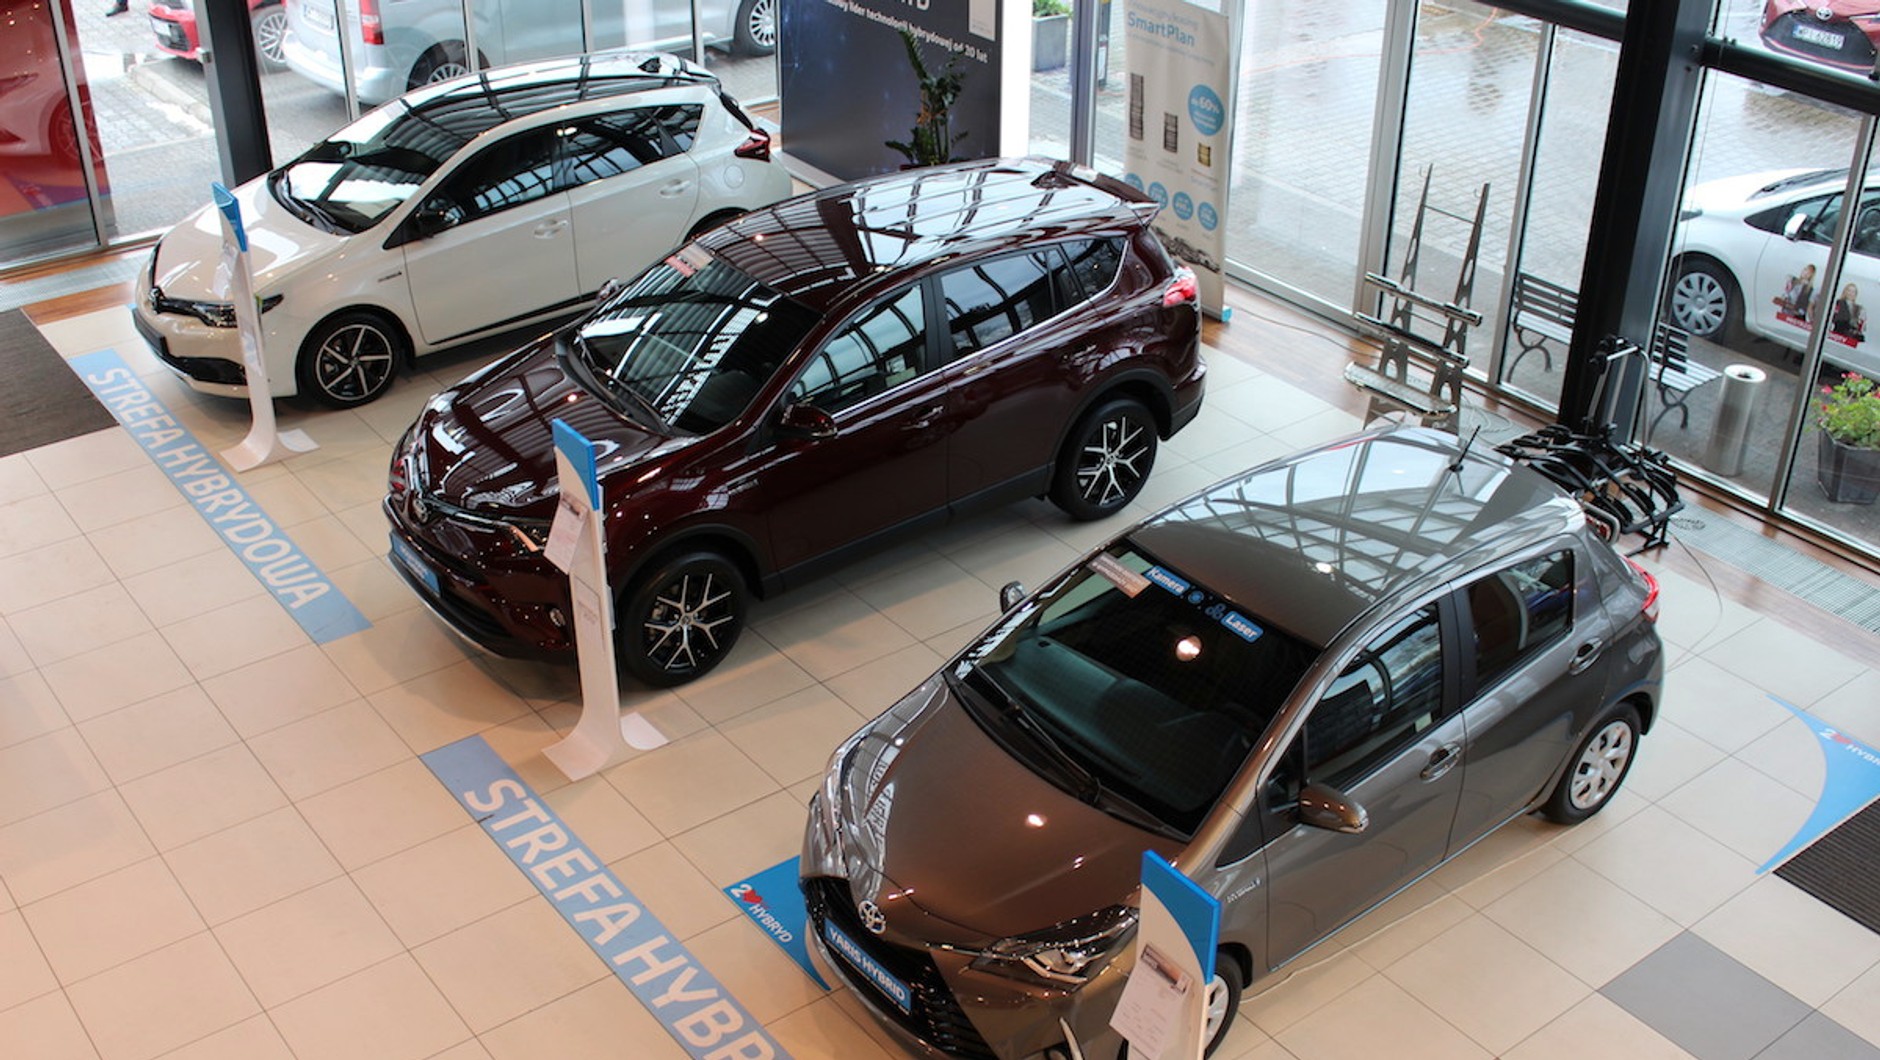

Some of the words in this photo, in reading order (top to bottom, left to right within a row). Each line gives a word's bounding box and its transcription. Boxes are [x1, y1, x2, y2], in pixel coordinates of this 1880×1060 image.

[1127, 11, 1195, 47] SmartPlan
[964, 43, 976, 58] 20
[976, 48, 988, 63] lat
[88, 367, 184, 449] STREFA
[158, 443, 331, 610] HYBRYDOWA
[1148, 567, 1185, 593] Kamera
[1226, 614, 1258, 638] Laser
[463, 778, 641, 946] STREFA
[749, 903, 793, 942] HYBRYD
[829, 926, 861, 963] YARIS
[862, 956, 905, 1001] HYBRID
